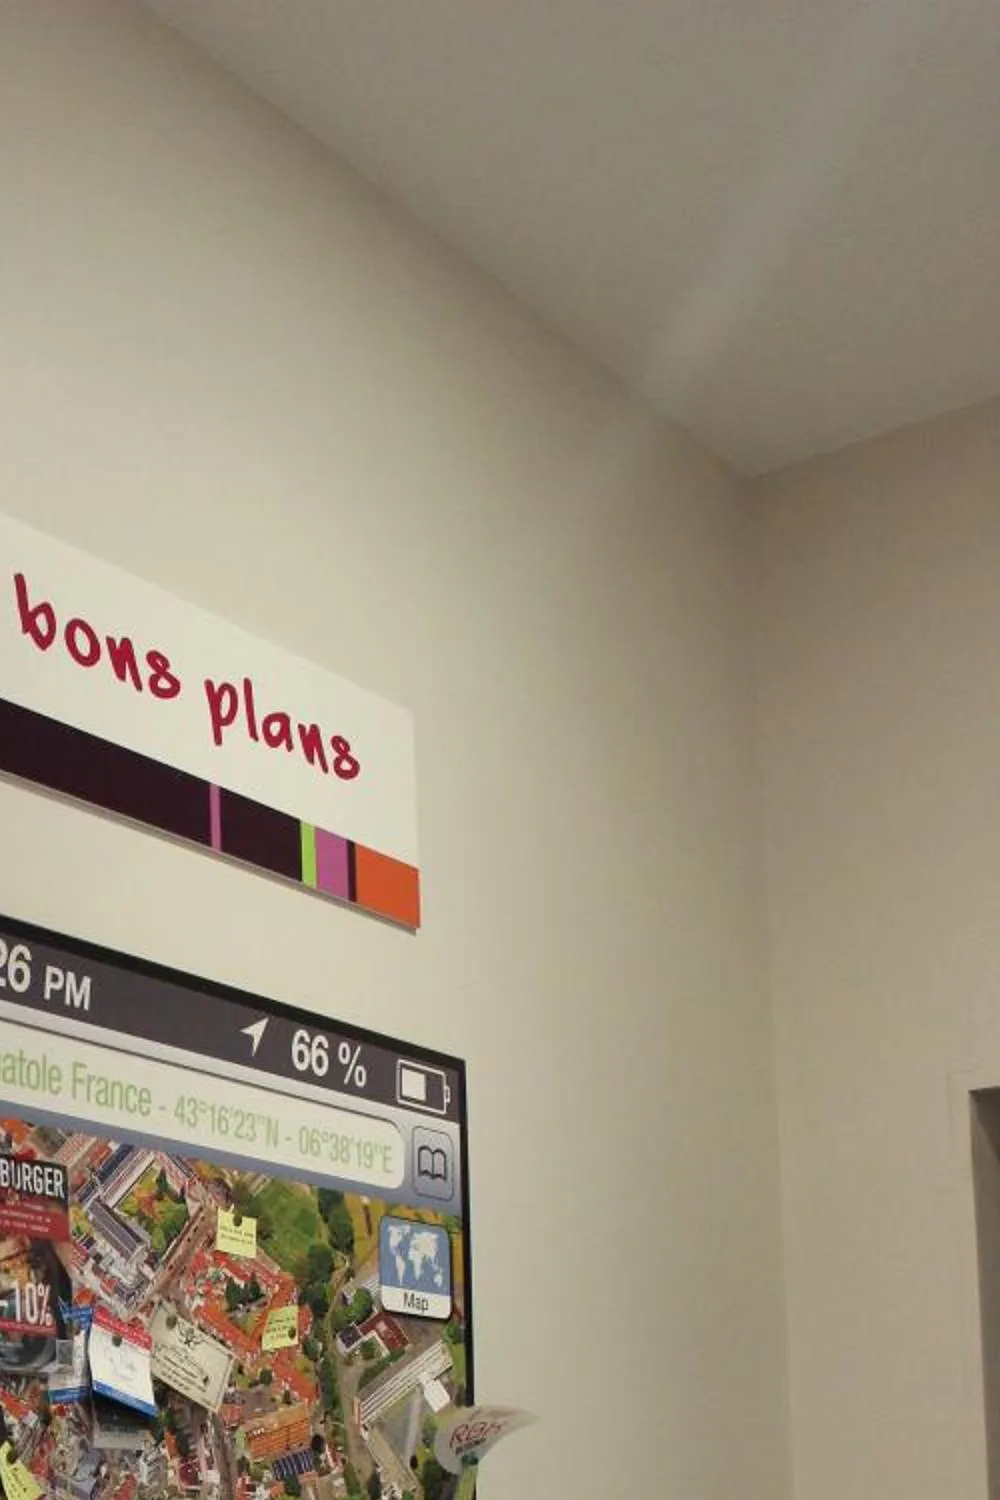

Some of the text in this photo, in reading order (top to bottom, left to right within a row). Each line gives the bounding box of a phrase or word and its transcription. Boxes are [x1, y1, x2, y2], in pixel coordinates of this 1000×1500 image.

[13, 573, 182, 699] bons
[204, 677, 361, 780] plans
[43, 965, 92, 1011] PM
[291, 1028, 367, 1088] 66 %
[71, 1061, 152, 1117] France
[0, 1159, 65, 1200] BURGER
[402, 1293, 430, 1313] Map
